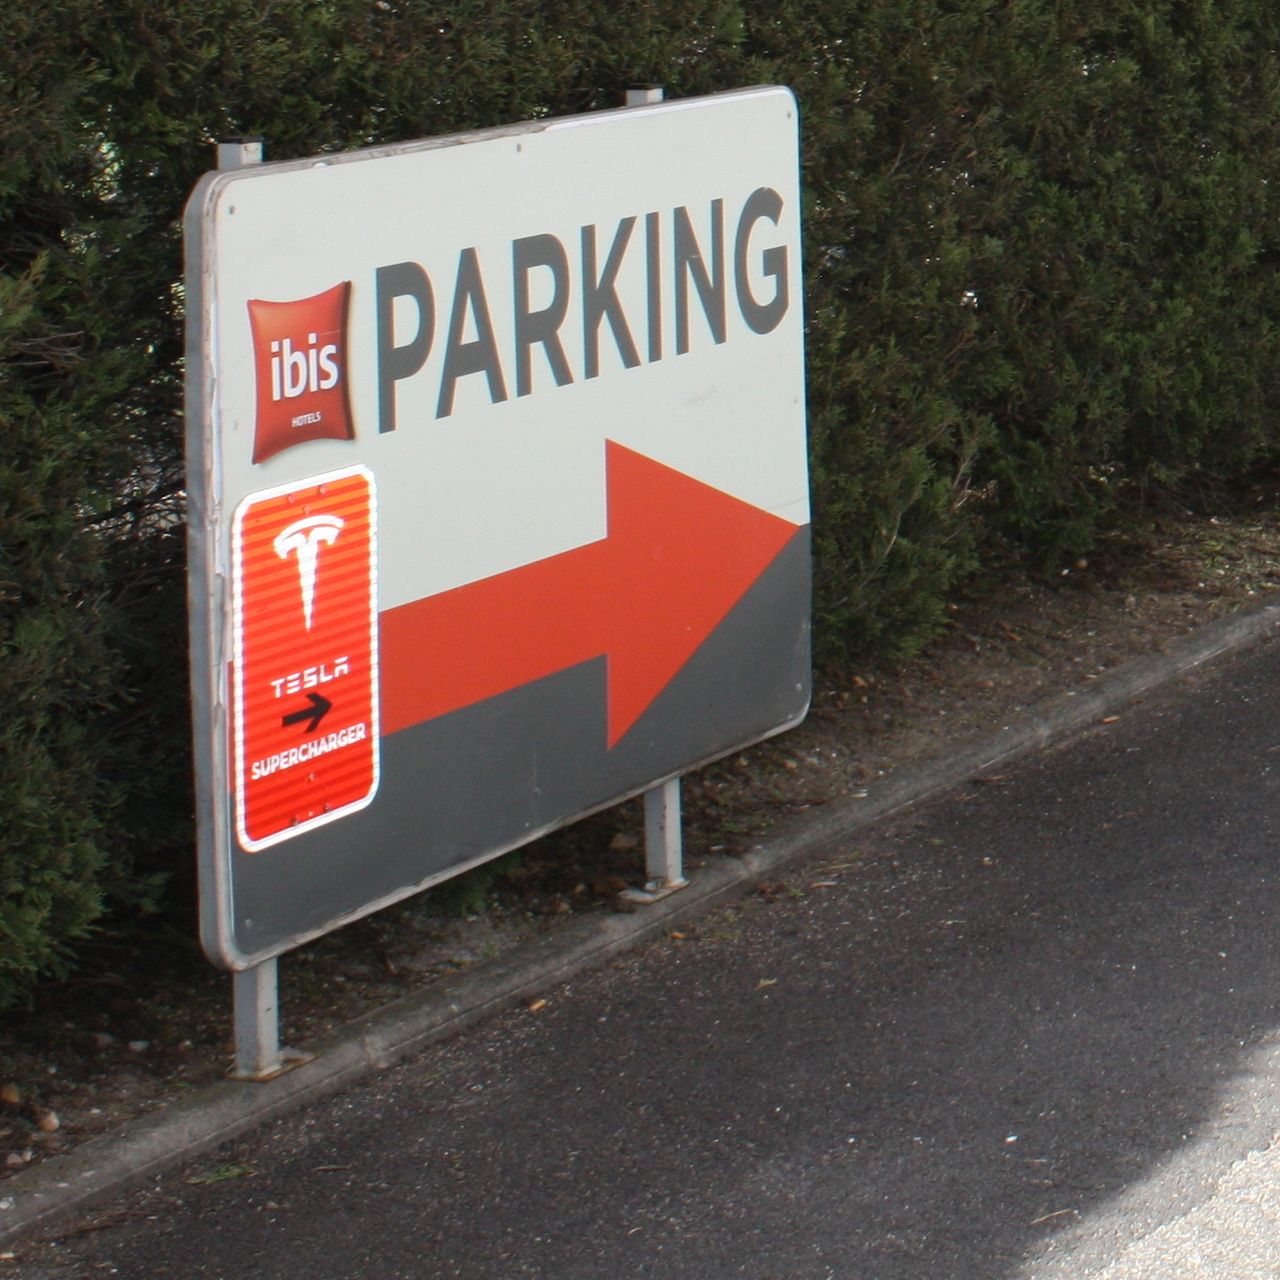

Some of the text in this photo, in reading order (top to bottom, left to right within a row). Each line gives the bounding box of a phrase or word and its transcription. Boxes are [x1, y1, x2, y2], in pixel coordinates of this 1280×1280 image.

[375, 187, 790, 434] PARKING
[271, 333, 339, 401] ibis
[291, 411, 321, 427] HOTELS
[270, 656, 349, 698] TESLA
[251, 722, 367, 780] SUPERCHARGER
